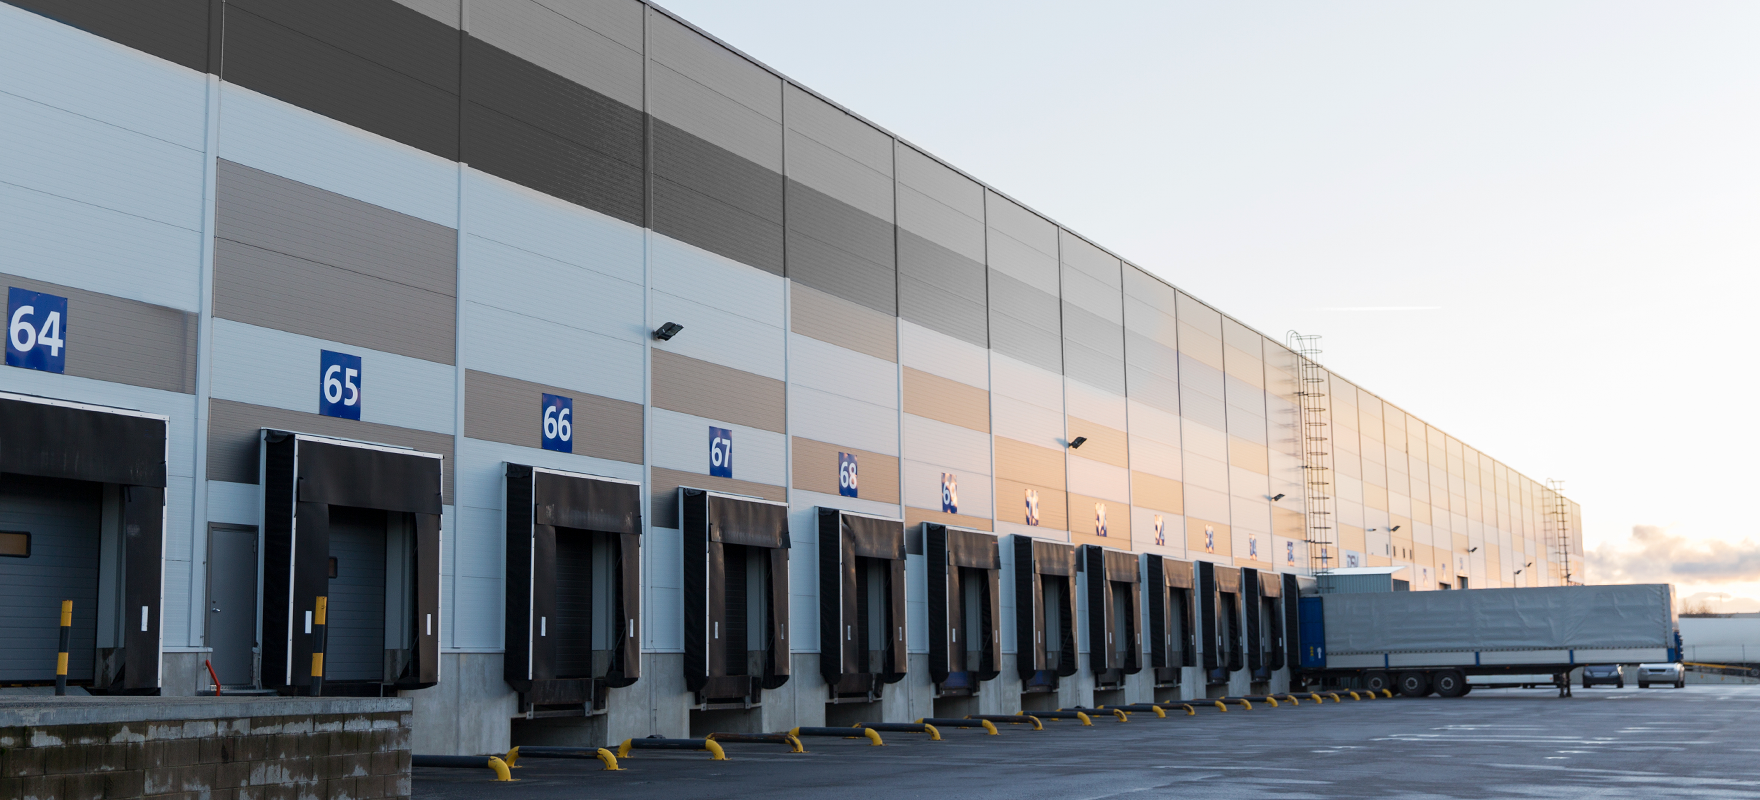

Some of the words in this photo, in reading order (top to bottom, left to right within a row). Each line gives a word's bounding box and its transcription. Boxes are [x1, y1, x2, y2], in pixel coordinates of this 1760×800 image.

[9, 305, 64, 357] 64
[323, 364, 359, 407] 65
[543, 405, 572, 442] 66
[711, 437, 731, 468] 67
[839, 461, 857, 490] 68
[942, 481, 957, 506] 69
